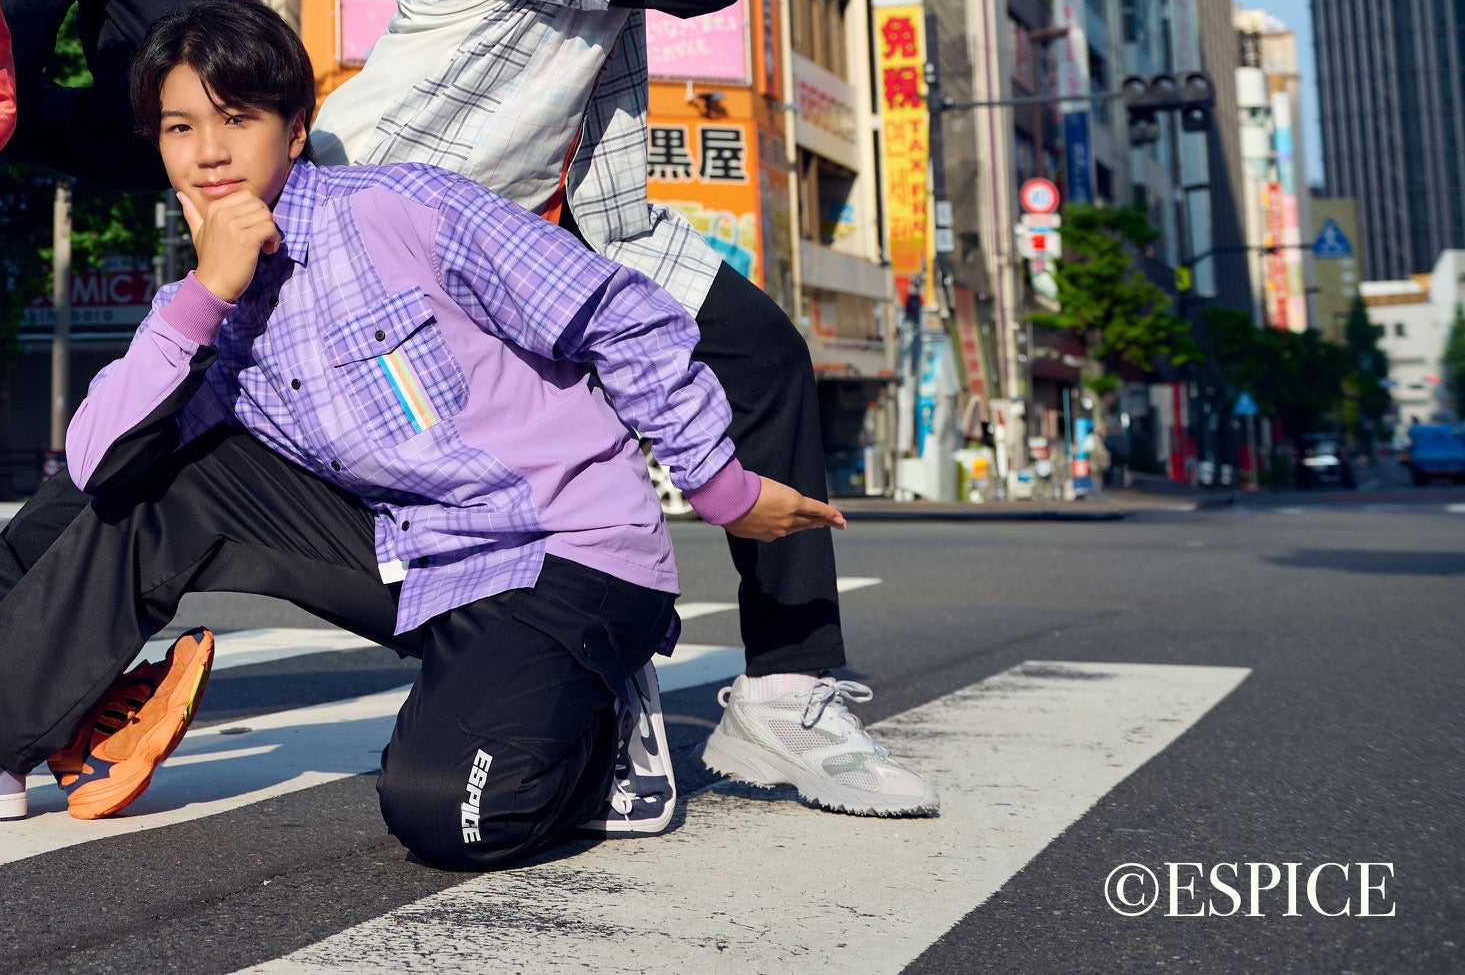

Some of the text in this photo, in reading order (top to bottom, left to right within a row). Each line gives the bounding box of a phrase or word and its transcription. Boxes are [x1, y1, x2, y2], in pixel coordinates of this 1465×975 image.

[881, 16, 921, 109] 免税
[648, 127, 748, 184] 黒屋
[460, 748, 494, 844] ESPICE
